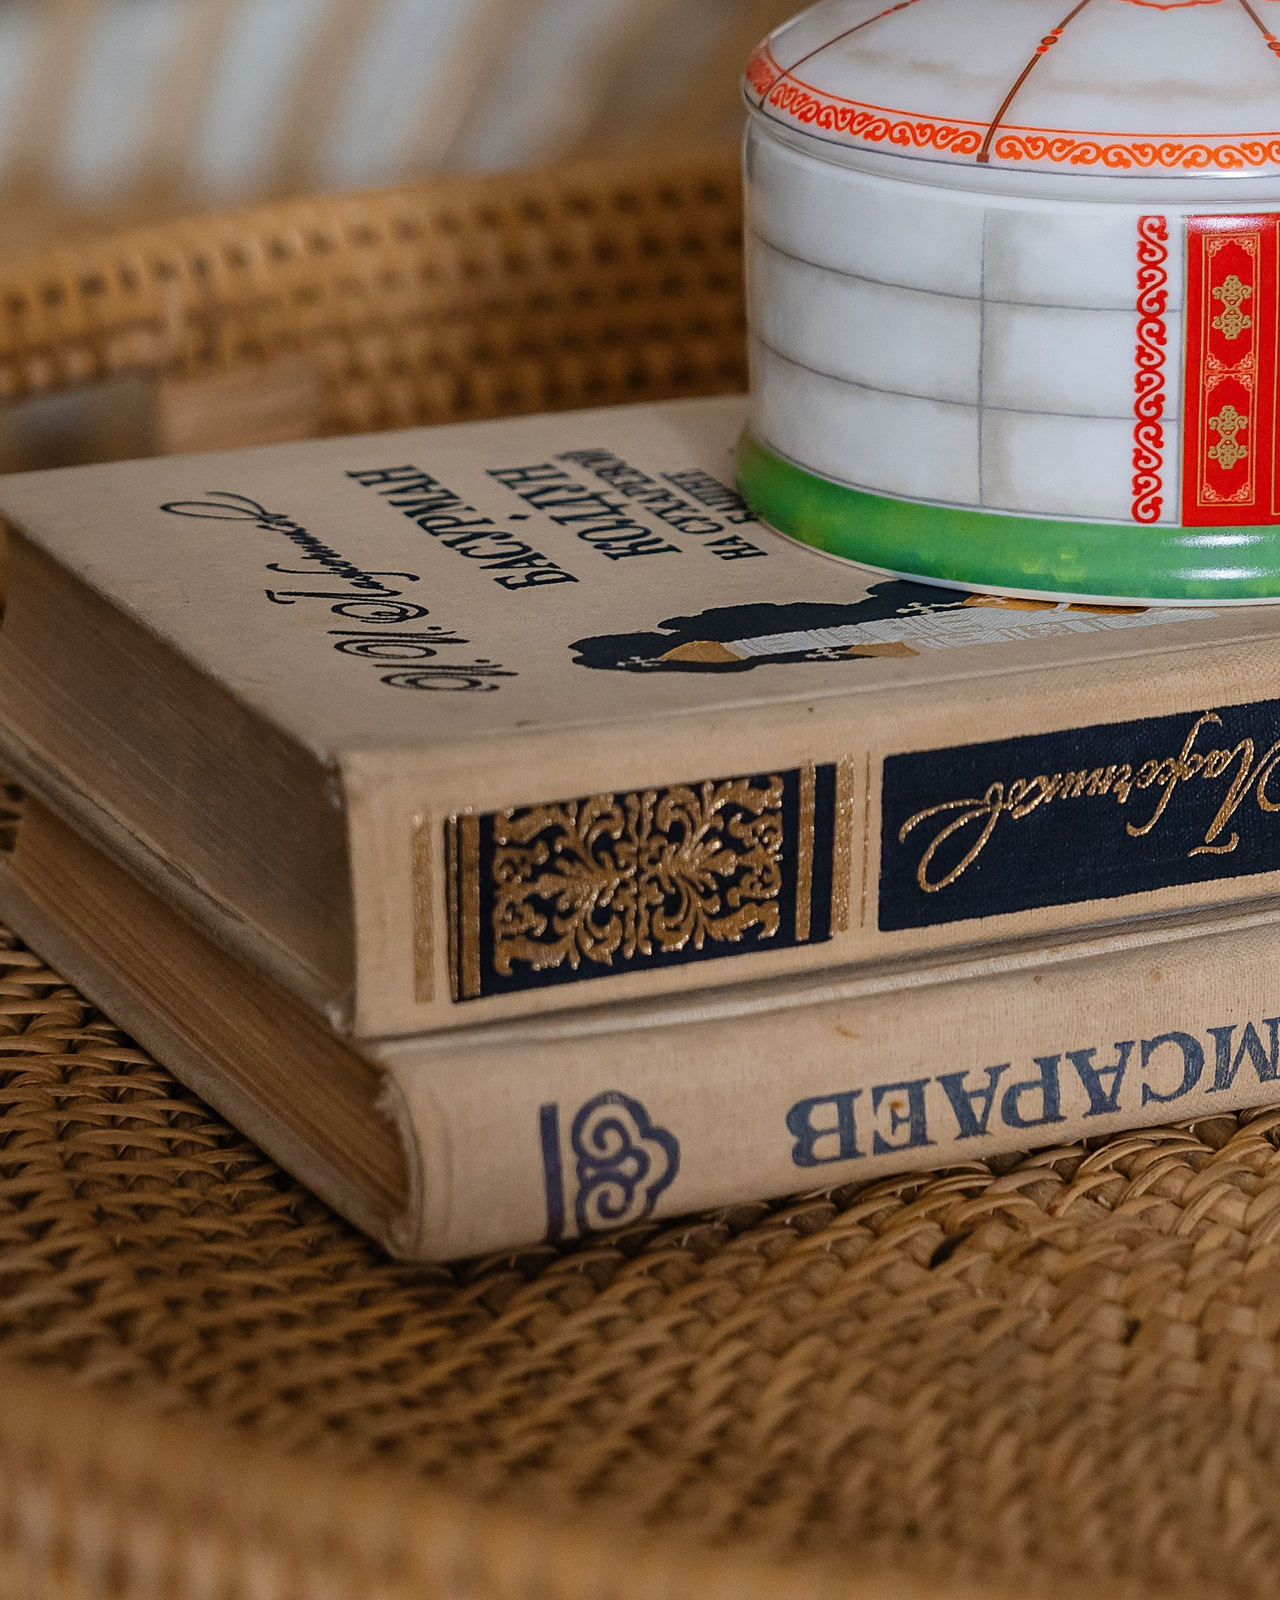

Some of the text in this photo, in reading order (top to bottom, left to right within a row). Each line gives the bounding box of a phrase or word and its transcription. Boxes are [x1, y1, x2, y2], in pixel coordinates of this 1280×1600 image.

[345, 464, 579, 590] БАСУРМАН
[485, 463, 683, 561] КОЛДУН
[703, 535, 769, 561] НА
[327, 626, 470, 659] И.
[373, 658, 519, 692] И.
